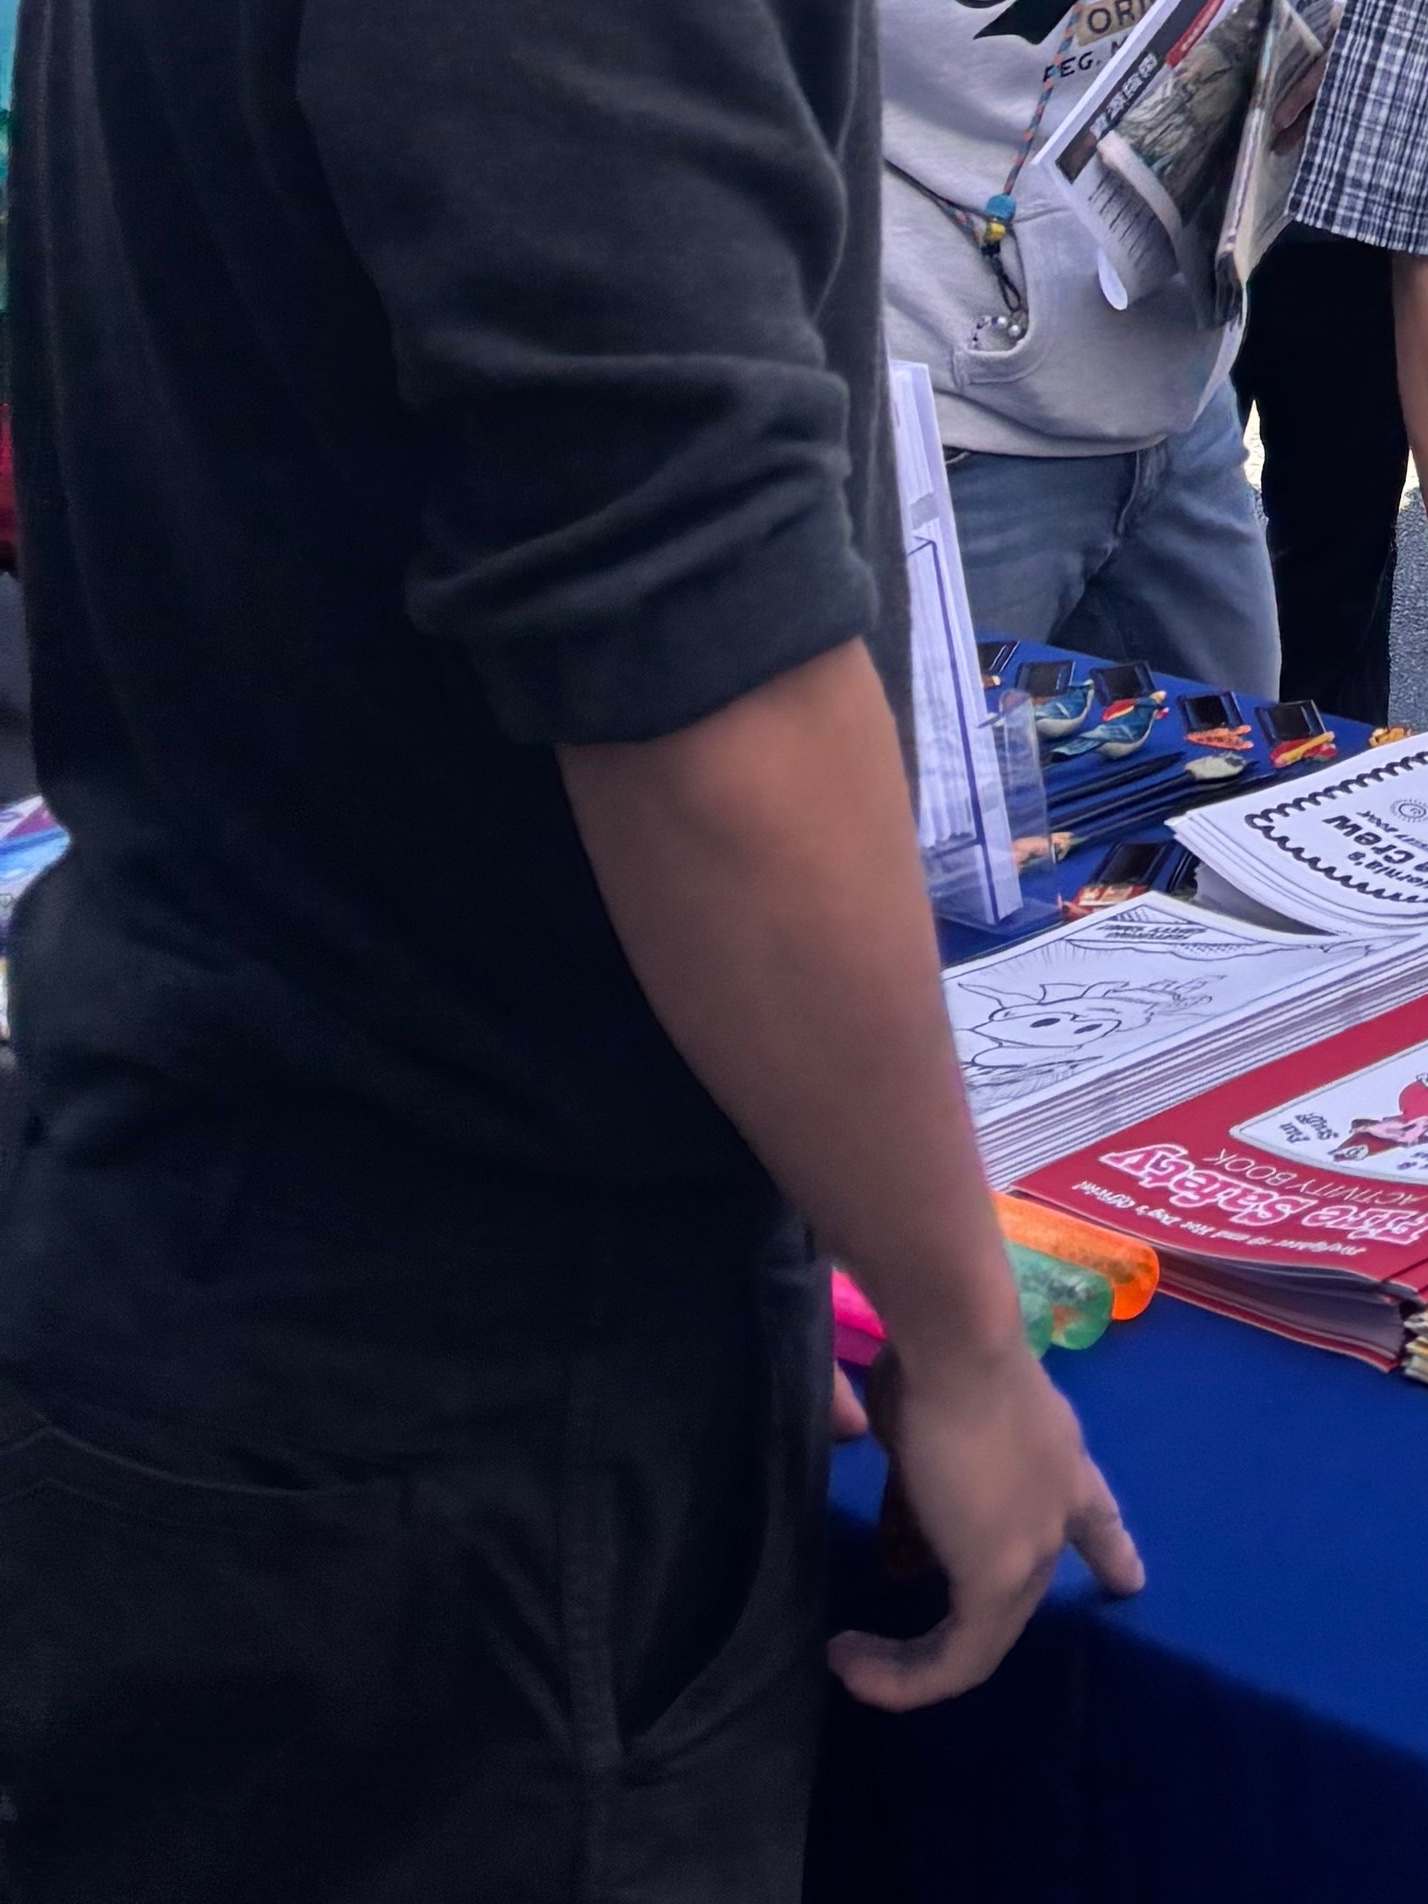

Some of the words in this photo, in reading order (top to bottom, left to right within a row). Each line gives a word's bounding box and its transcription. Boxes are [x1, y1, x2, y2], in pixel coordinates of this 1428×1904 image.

[1321, 815, 1416, 864] Crew
[1098, 1143, 1318, 1226] Safety
[1202, 1148, 1298, 1187] BOOK
